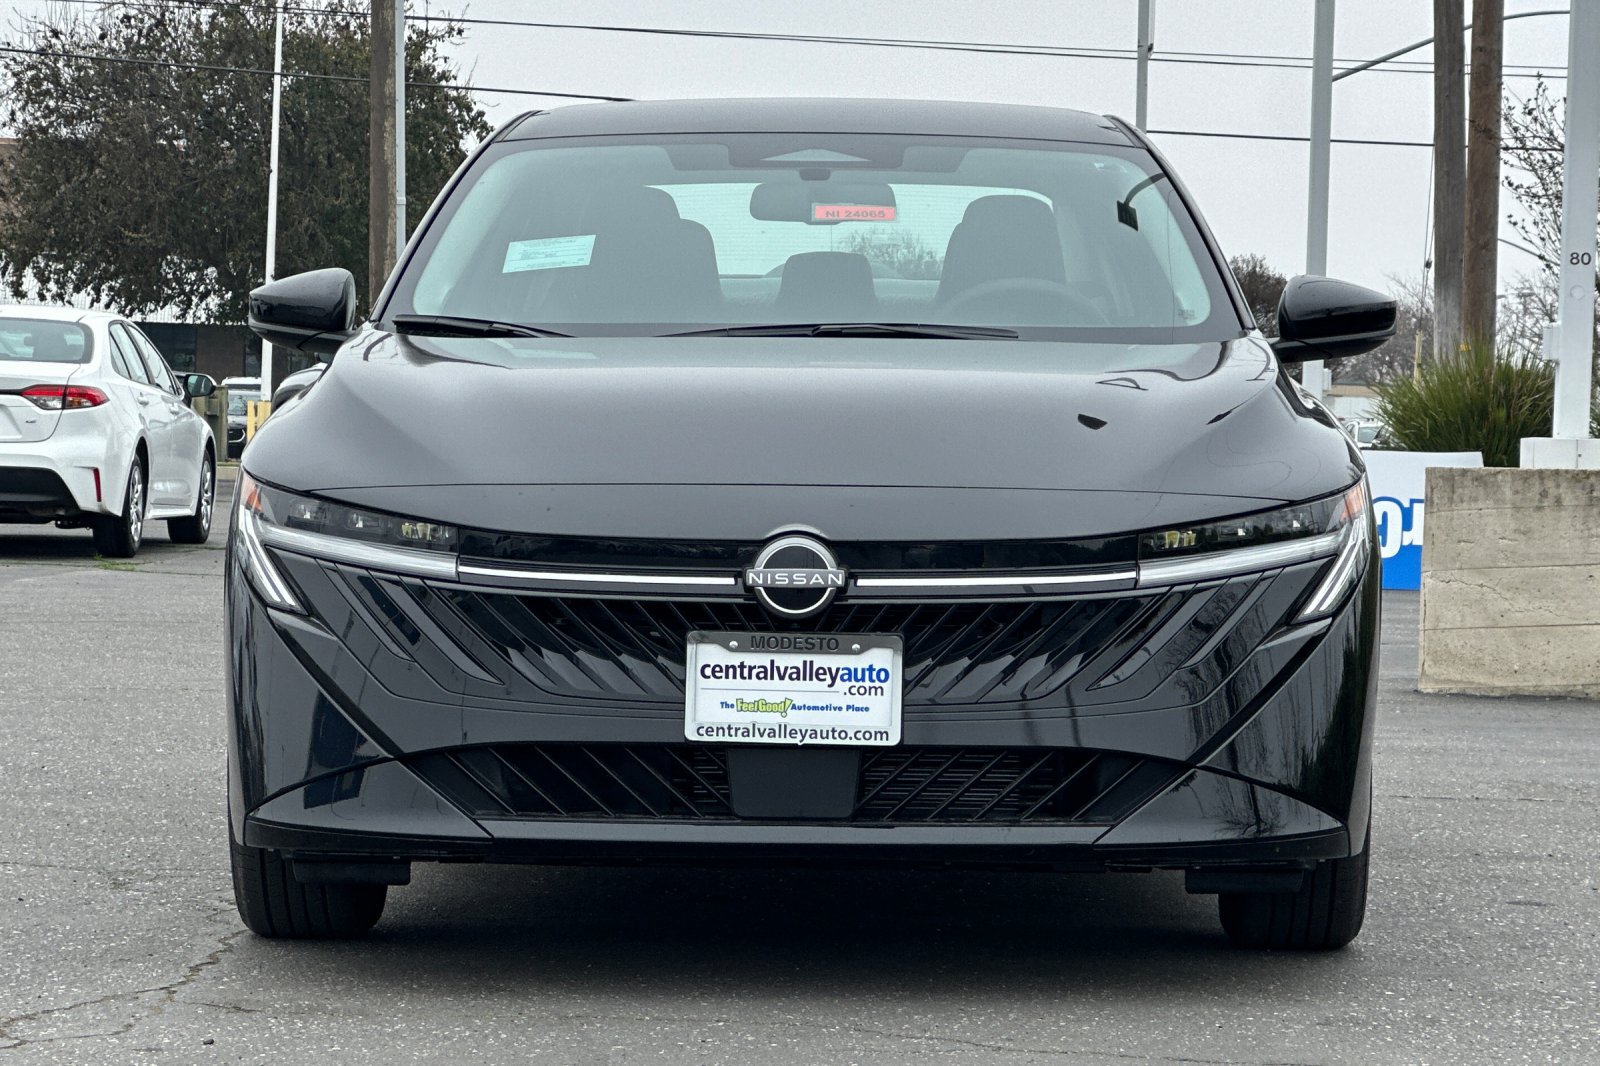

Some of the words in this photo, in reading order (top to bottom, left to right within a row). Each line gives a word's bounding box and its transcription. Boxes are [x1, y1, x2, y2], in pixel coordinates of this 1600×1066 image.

[1570, 252, 1592, 266] 80
[748, 572, 843, 585] NISSAN
[750, 635, 840, 651] MODESTO
[699, 659, 890, 688] centralvalleyauto
[843, 685, 884, 697] .com
[720, 701, 735, 709] The
[790, 703, 843, 713] Automotive
[846, 704, 870, 713] Place
[696, 723, 890, 743] centralvalleyauto.com
